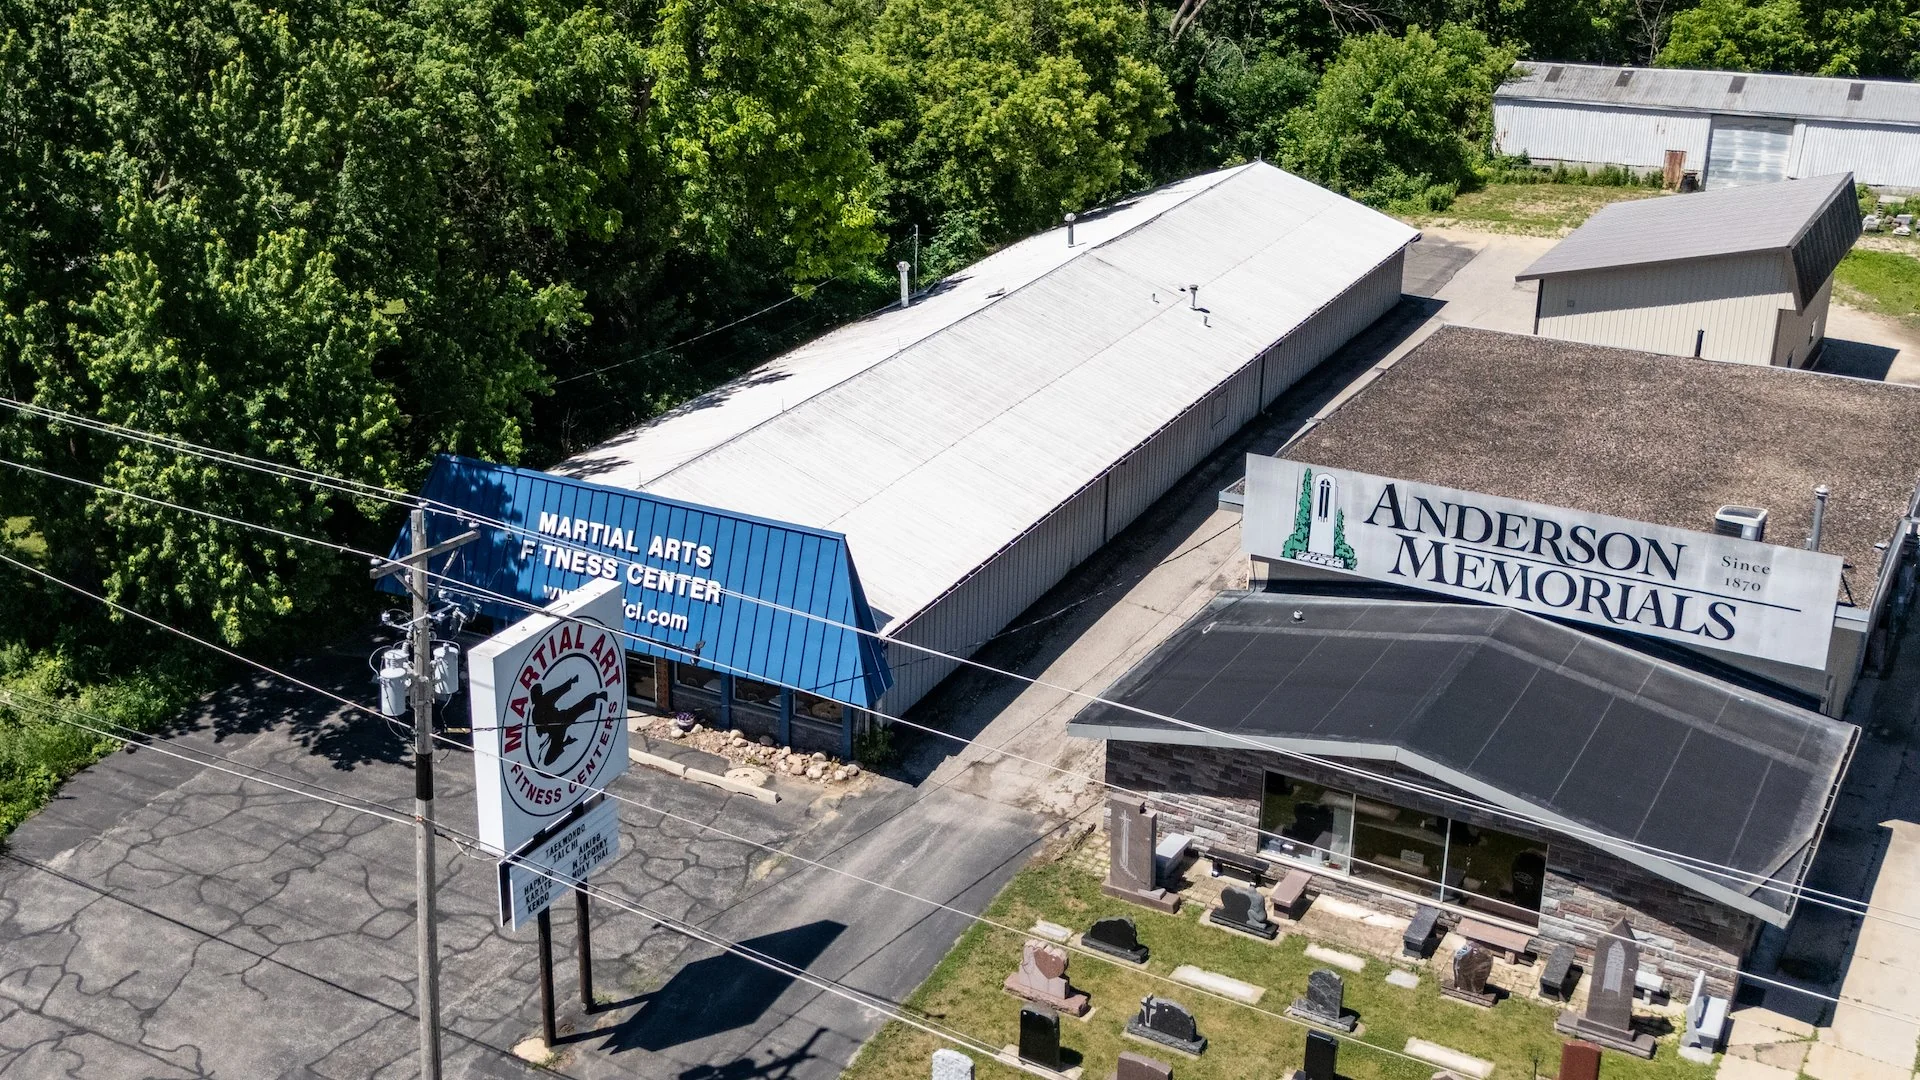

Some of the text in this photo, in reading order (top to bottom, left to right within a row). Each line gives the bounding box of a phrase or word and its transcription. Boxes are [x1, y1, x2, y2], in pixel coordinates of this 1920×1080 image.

[539, 512, 712, 567] MARTIAL ARTS
[1364, 483, 1686, 580] ANDERSON
[1721, 554, 1771, 576] Since
[521, 540, 721, 605] FTNESS CENTER
[1388, 534, 1736, 641] MEMORIALS
[1724, 576, 1762, 592] 1870
[505, 625, 620, 753] MARTIAL ART
[511, 701, 617, 804] FITNESS CENTERS
